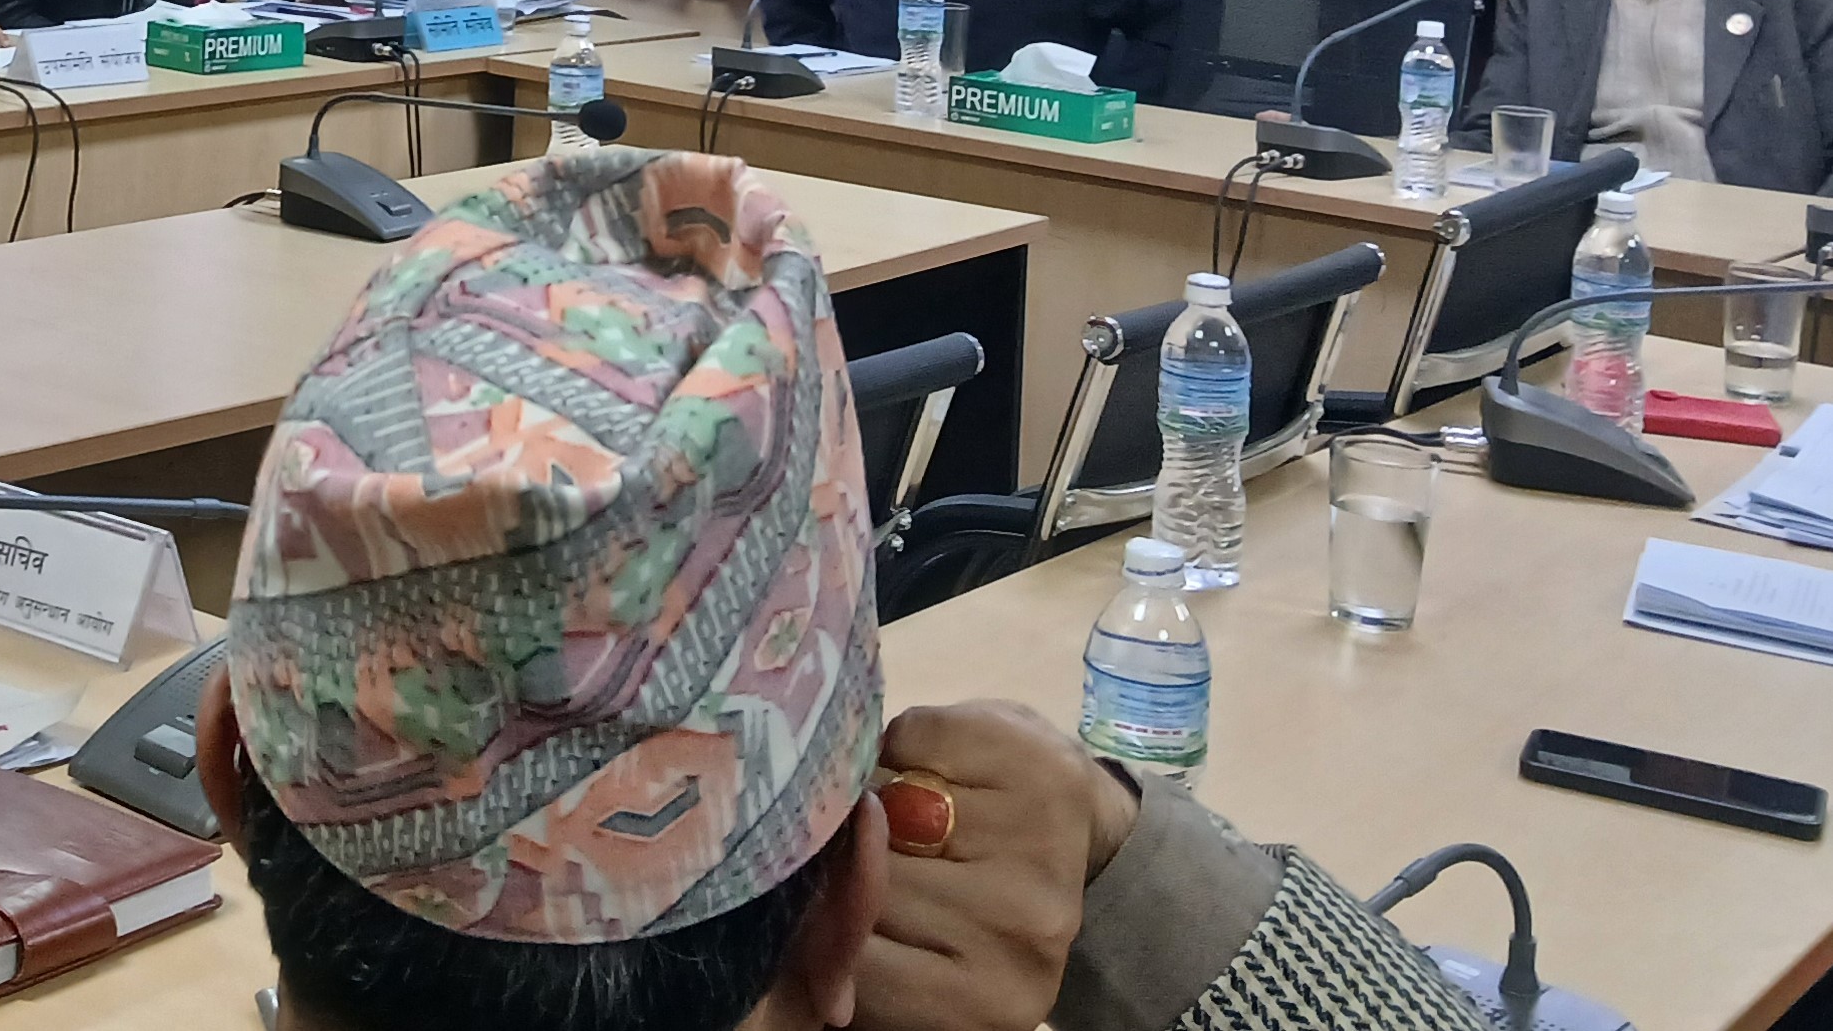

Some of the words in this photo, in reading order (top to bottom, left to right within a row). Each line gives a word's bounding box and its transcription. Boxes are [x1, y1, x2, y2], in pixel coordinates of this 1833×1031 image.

[204, 33, 282, 60] PREMIUM
[951, 85, 1060, 123] PREMIUM
[76, 611, 115, 637] आयोग
